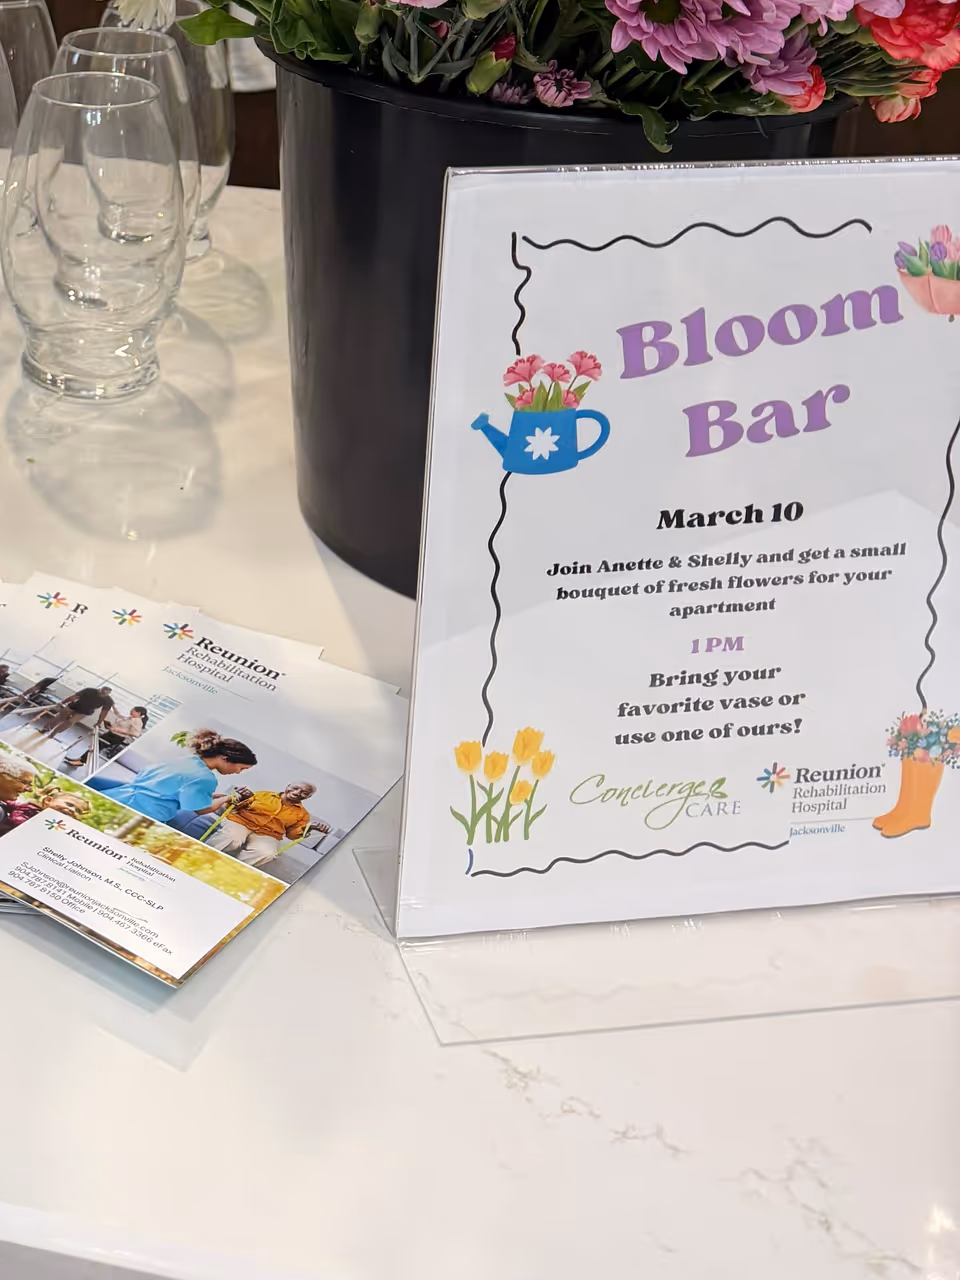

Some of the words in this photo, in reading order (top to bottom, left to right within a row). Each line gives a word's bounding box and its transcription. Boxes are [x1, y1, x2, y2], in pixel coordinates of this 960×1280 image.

[616, 284, 904, 379] Bloom
[682, 383, 850, 458] Bar
[656, 503, 764, 530] March
[770, 501, 804, 523] 10
[546, 561, 592, 576] Join
[596, 557, 664, 573] Anette
[668, 555, 682, 568] &
[687, 551, 753, 568] Shelly
[755, 548, 794, 564] and
[797, 547, 830, 564] get
[833, 548, 846, 559] a
[850, 542, 907, 558] small
[556, 582, 640, 600] bouquet
[643, 579, 666, 594] of
[668, 576, 723, 593] fresh
[727, 573, 805, 589] flowers
[807, 570, 840, 584] for
[843, 569, 893, 586] your
[669, 597, 776, 619] apartment
[193, 636, 284, 681] Reunion
[690, 639, 700, 654] 1
[704, 636, 745, 653] PM
[162, 665, 218, 695] Jacksonville
[176, 653, 235, 684] Hospital
[185, 646, 278, 692] Rehabilitation
[649, 669, 720, 688] Bring
[722, 667, 782, 686] your
[617, 697, 715, 718] favorite
[719, 695, 774, 710] vase
[778, 693, 806, 707] or
[614, 731, 657, 745] use
[661, 728, 704, 742] one
[708, 722, 734, 739] of
[737, 718, 803, 737] ours!
[794, 763, 883, 784] Reunion
[569, 773, 712, 831] Concierge
[792, 782, 887, 800] Rehabilitation
[685, 800, 741, 818] CARE
[791, 798, 848, 815] Hospital
[65, 828, 123, 861] Reunion
[789, 823, 846, 838] Jacksonville
[36, 850, 66, 868] Clinical
[63, 864, 92, 882] Liaison
[42, 846, 68, 861] Shelly
[66, 859, 103, 881] Johnson,
[124, 888, 164, 910] CCC-SLP
[126, 860, 155, 877] Hospital
[130, 857, 176, 883] Rehabilitation
[60, 898, 86, 915] Office
[66, 892, 94, 911] Mobile
[152, 940, 174, 956] eFax
